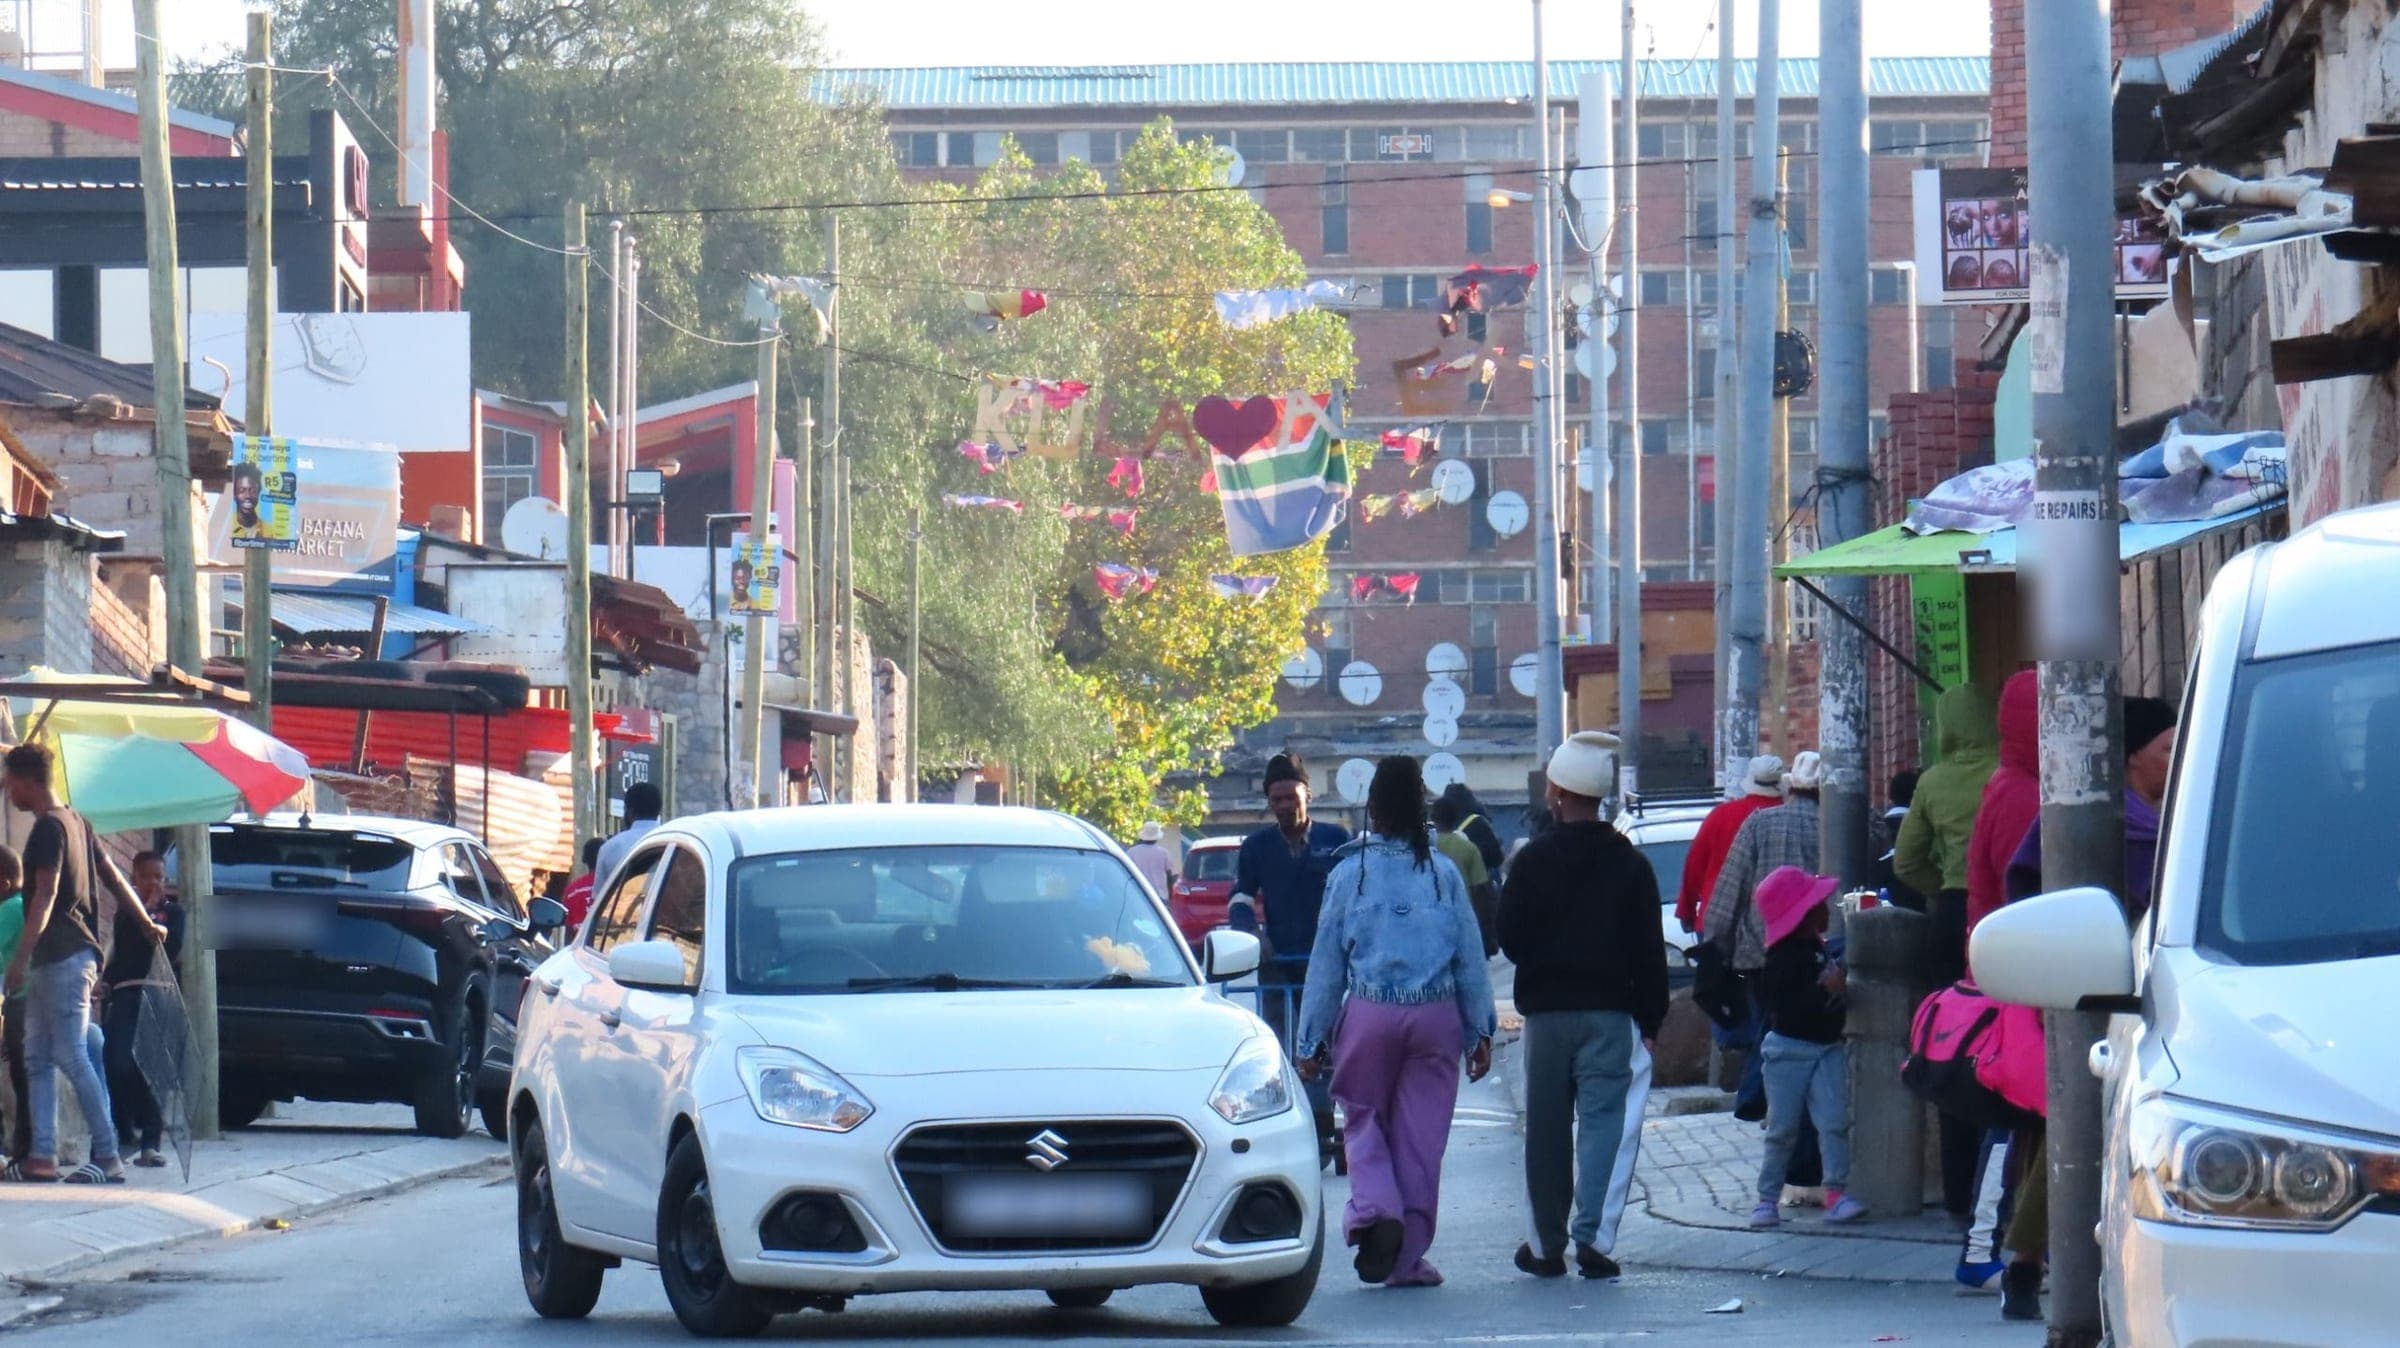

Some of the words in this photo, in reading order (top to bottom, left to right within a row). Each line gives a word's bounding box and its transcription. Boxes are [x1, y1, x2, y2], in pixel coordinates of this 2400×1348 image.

[264, 476, 280, 488] R5
[2047, 502, 2097, 520] REPAIRS
[303, 517, 365, 540] BAFANA
